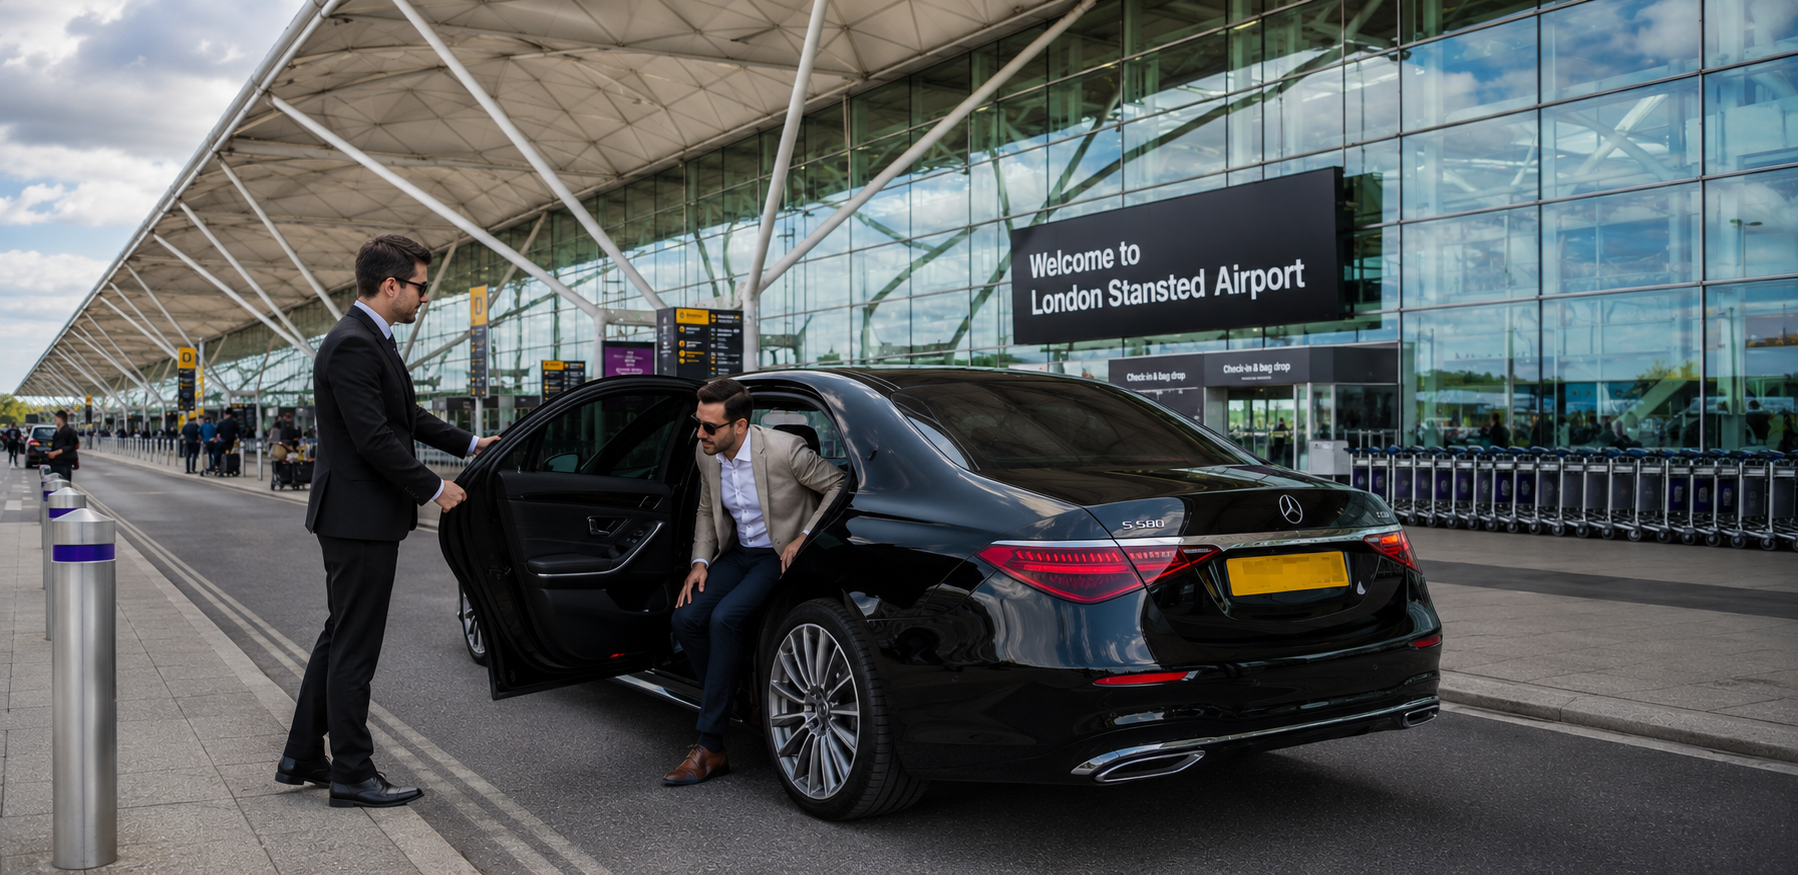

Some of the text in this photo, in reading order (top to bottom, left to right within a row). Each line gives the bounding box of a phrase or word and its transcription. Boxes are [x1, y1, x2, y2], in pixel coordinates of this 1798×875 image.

[1029, 241, 1141, 279] Welcome to
[1031, 258, 1306, 315] London Stansted Airport
[1223, 362, 1291, 374] Check-in & bag drop
[1126, 372, 1153, 382] Check-in
[1158, 372, 1170, 382] bag
[1171, 371, 1186, 382] drop
[1122, 518, 1165, 530] S 580
